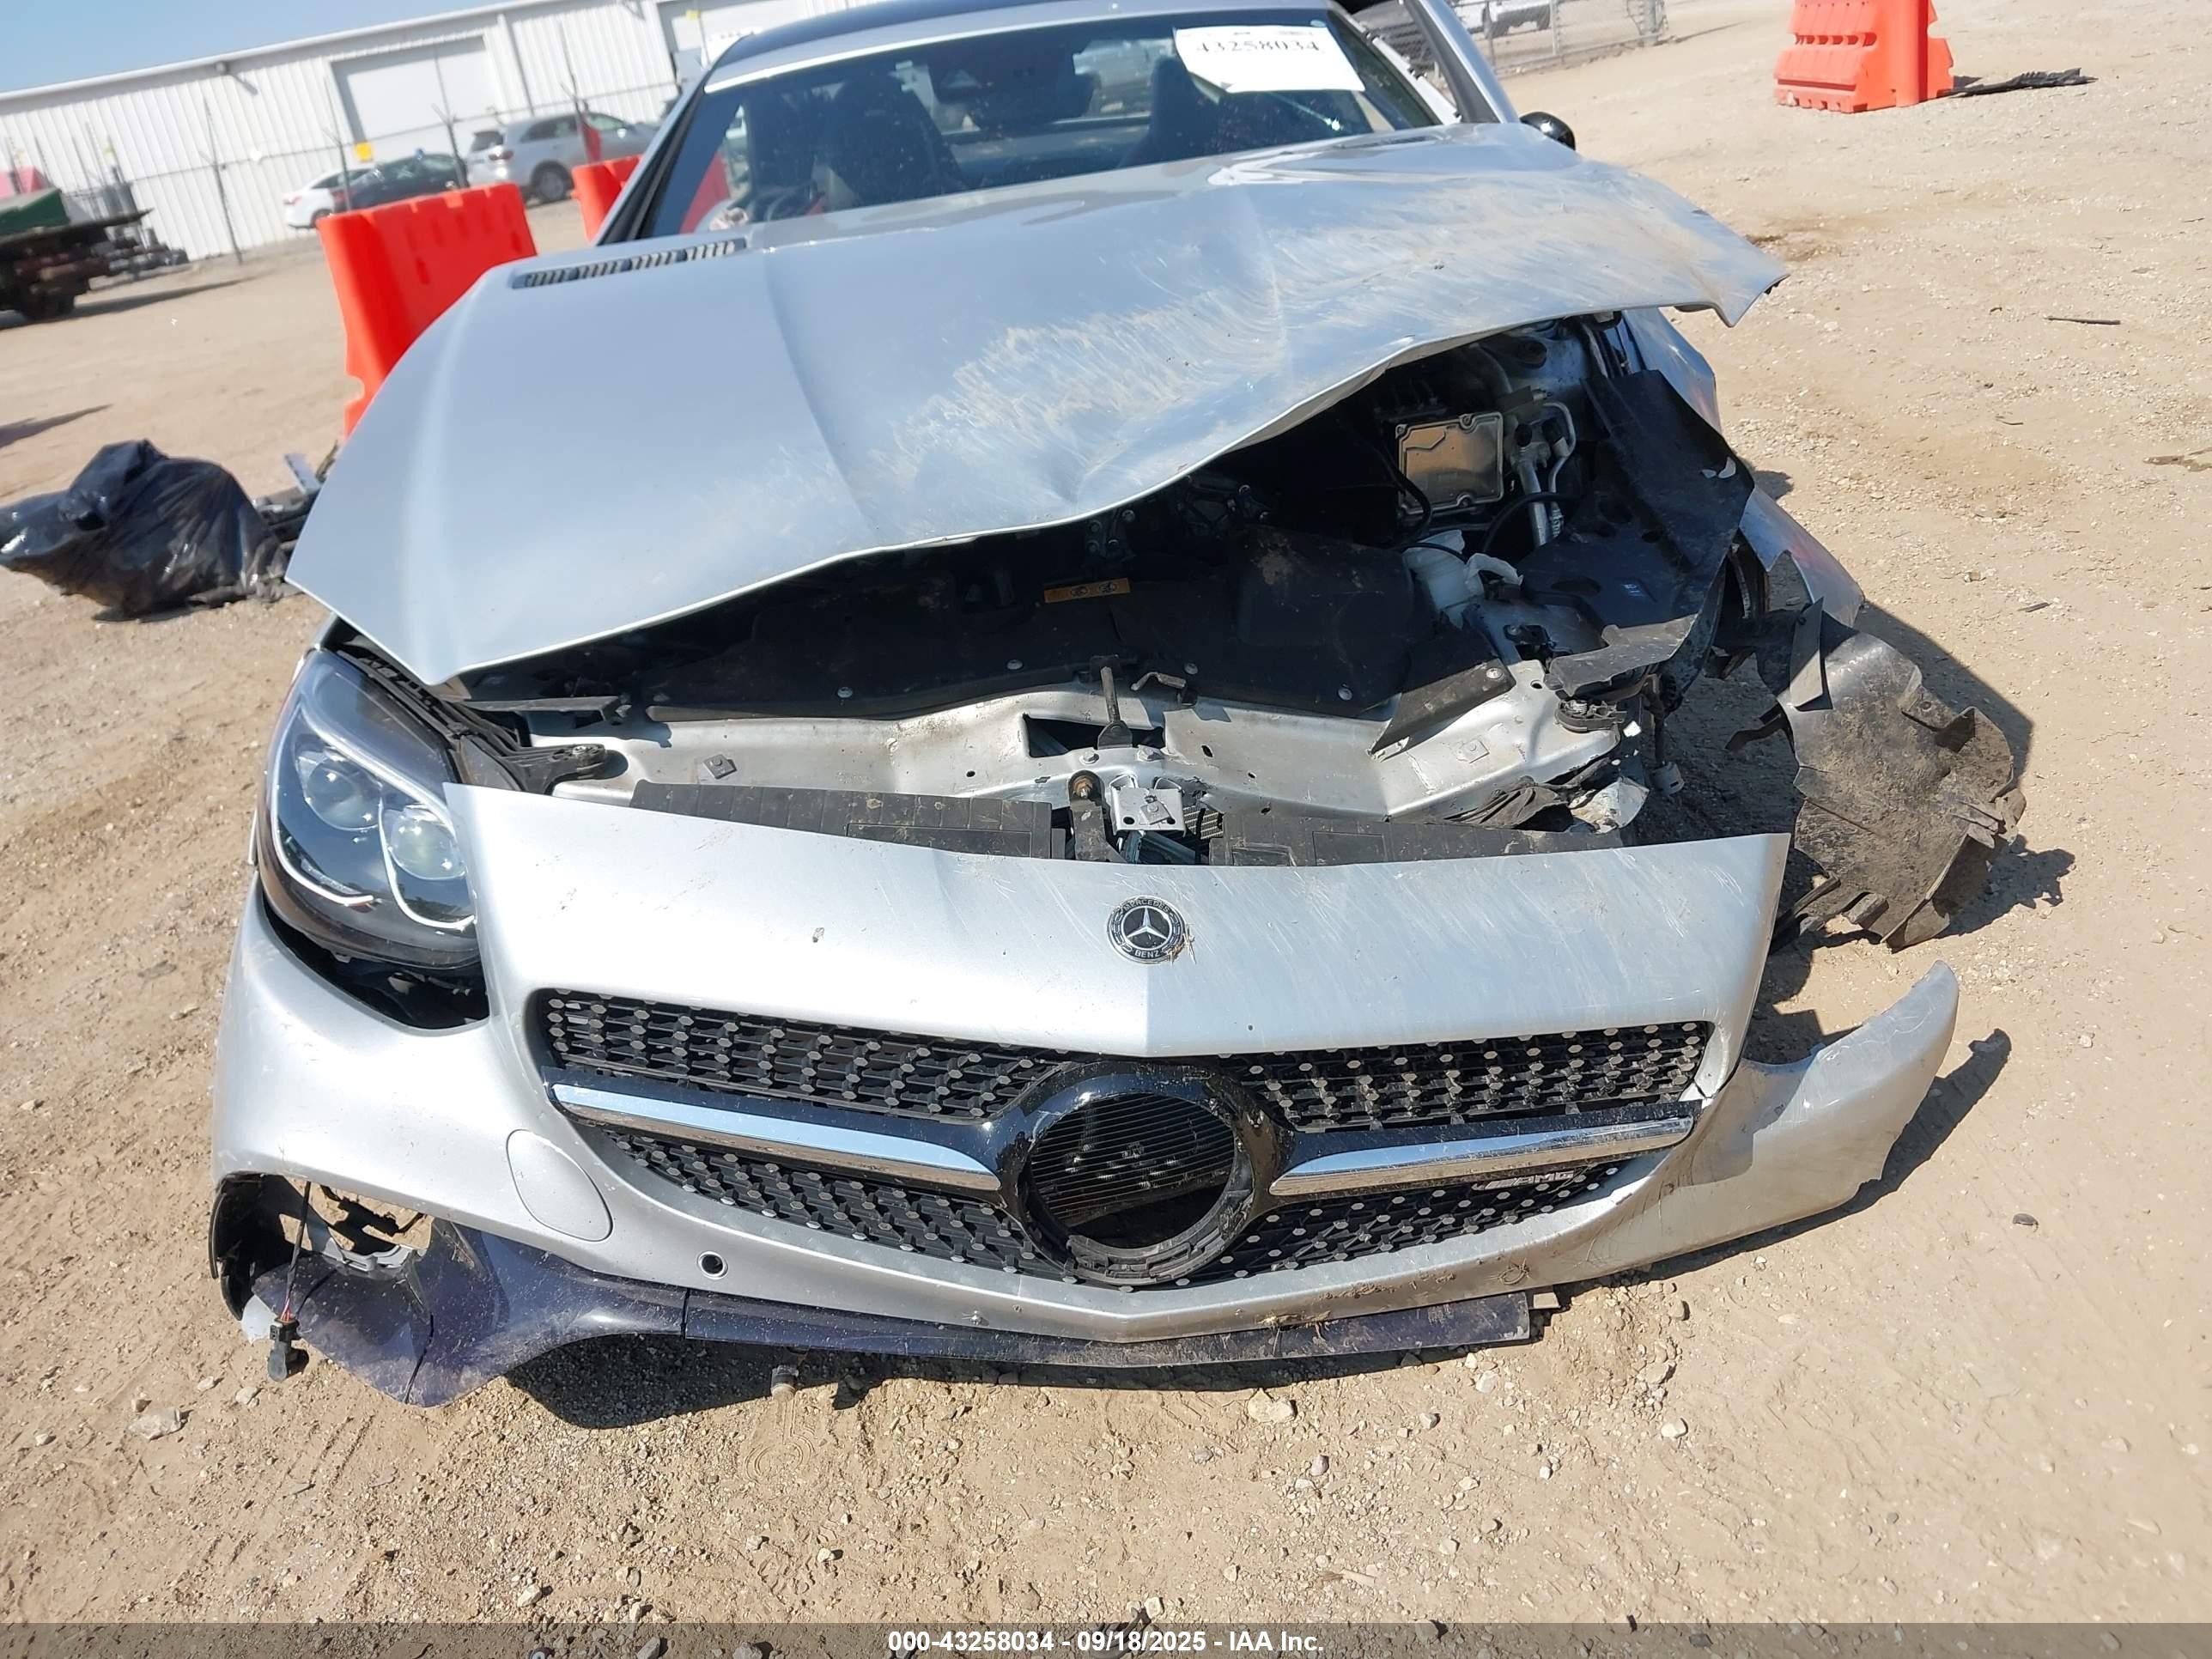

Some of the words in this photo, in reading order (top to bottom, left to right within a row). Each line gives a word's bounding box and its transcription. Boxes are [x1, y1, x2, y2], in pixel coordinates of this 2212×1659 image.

[1196, 40, 1320, 53] 43258034
[1123, 898, 1170, 912] MERCEDES
[1134, 950, 1161, 958] BENZ
[1513, 1170, 1574, 1185] AMG
